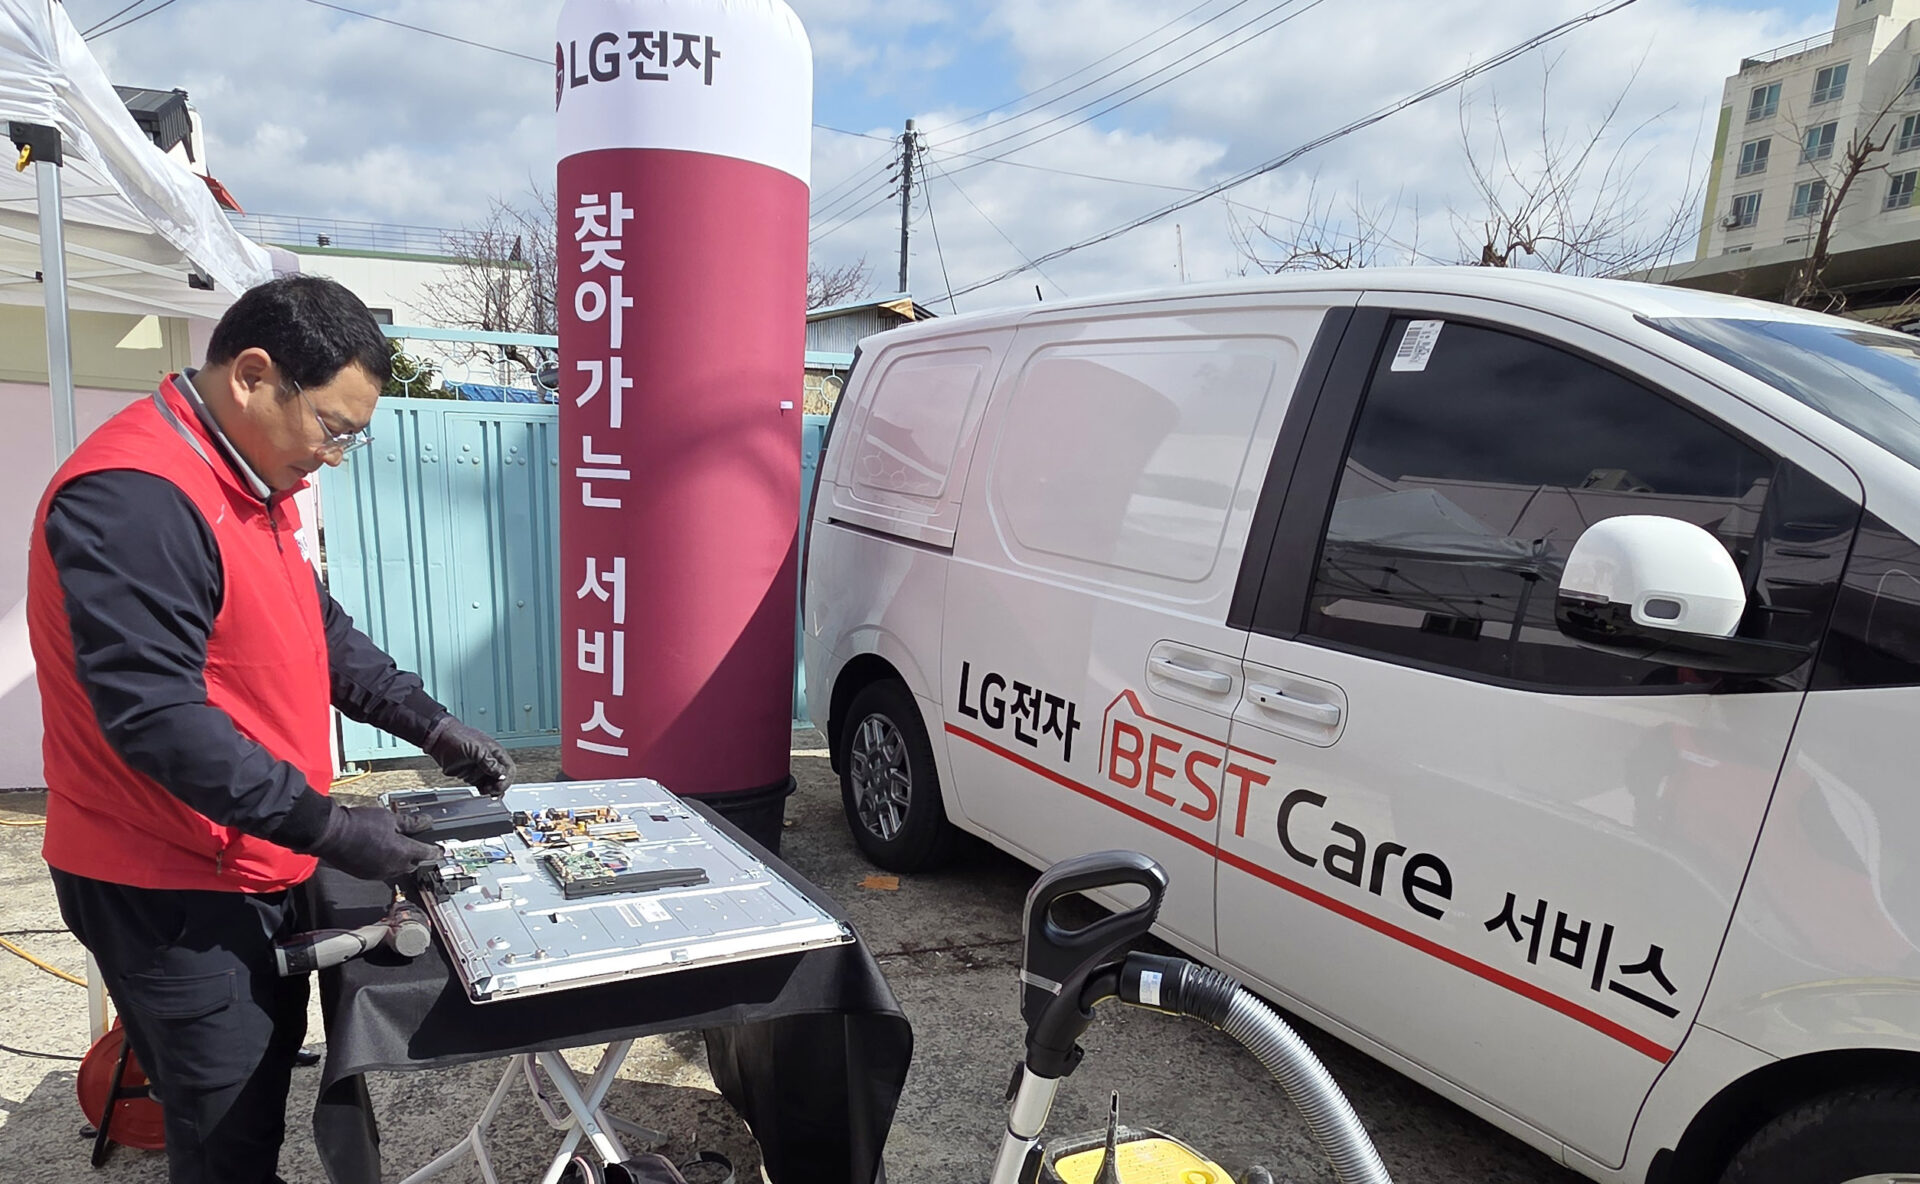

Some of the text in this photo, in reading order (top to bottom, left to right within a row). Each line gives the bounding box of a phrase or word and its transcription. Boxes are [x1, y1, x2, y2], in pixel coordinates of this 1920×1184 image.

[570, 30, 721, 89] LG전자
[574, 192, 635, 757] 찾아가는 서비스
[958, 661, 1680, 1019] LG전자 BEST Care 서비스
